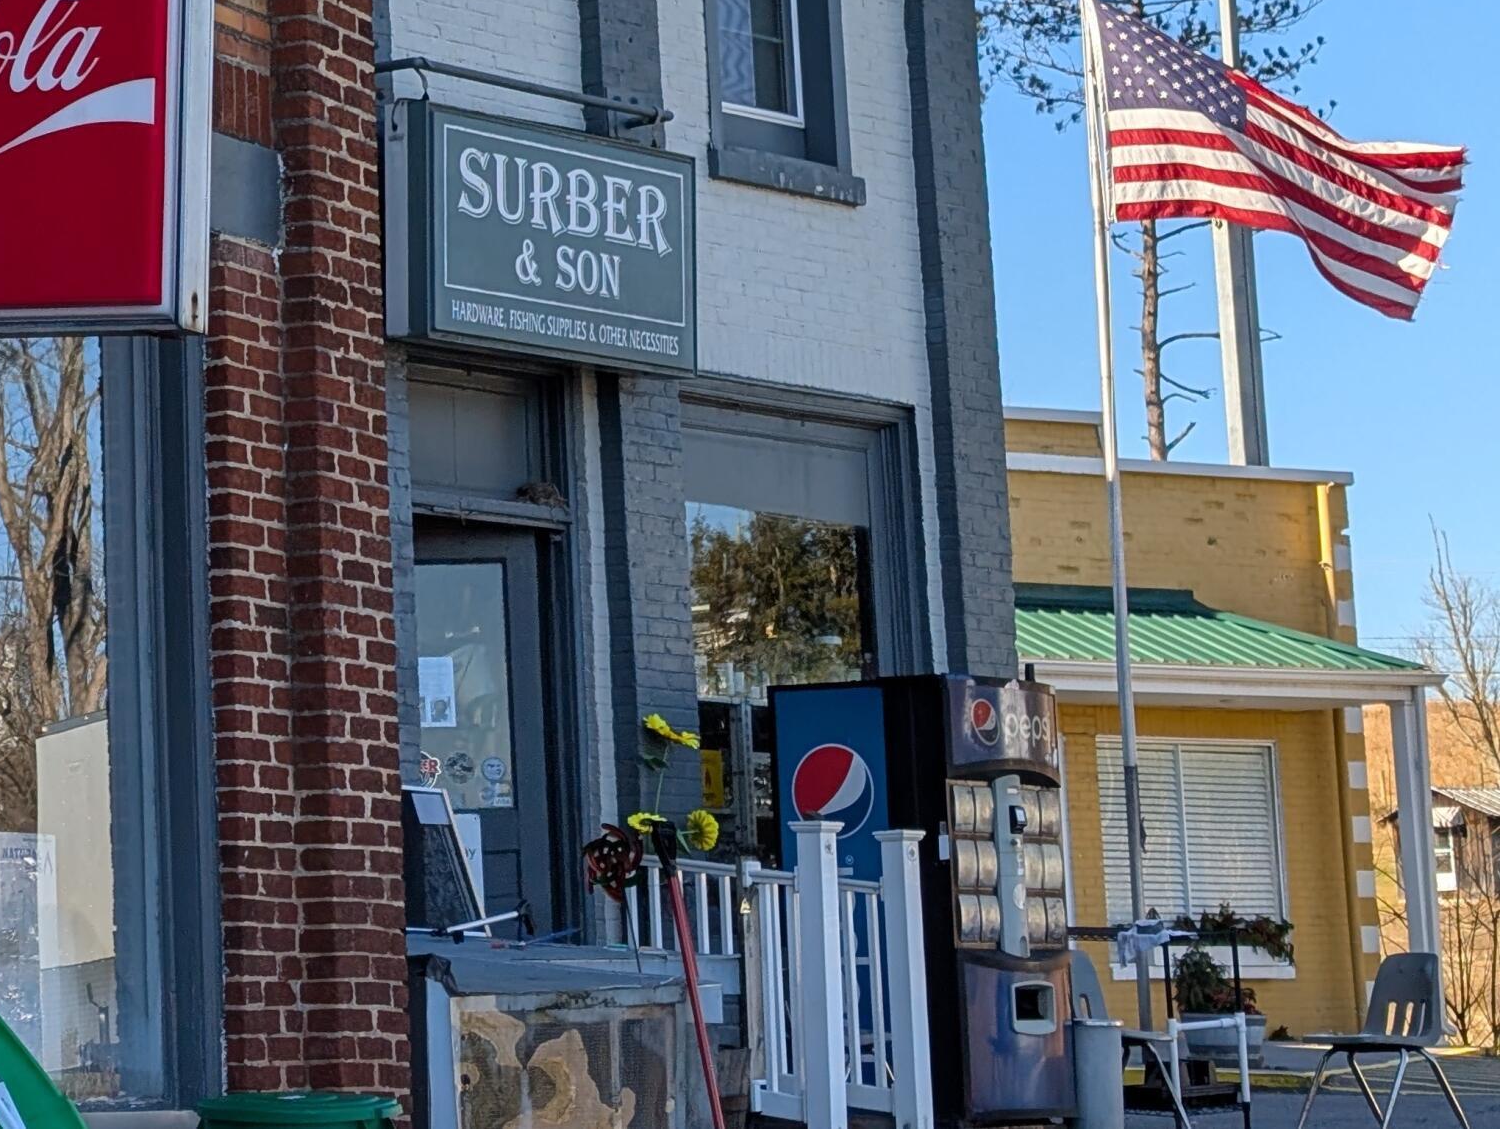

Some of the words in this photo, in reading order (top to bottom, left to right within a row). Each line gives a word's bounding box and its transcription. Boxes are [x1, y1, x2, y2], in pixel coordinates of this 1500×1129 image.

[457, 148, 673, 258] SURBER
[515, 238, 542, 287] &
[555, 245, 622, 300] SON
[451, 299, 507, 330] HARDWARE,
[509, 309, 545, 334] FISHING
[547, 315, 587, 341] SUPPLIES
[588, 325, 597, 342] &
[598, 325, 628, 347] OTHER
[629, 330, 679, 355] NECESSITIES
[1004, 712, 1052, 747] peps
